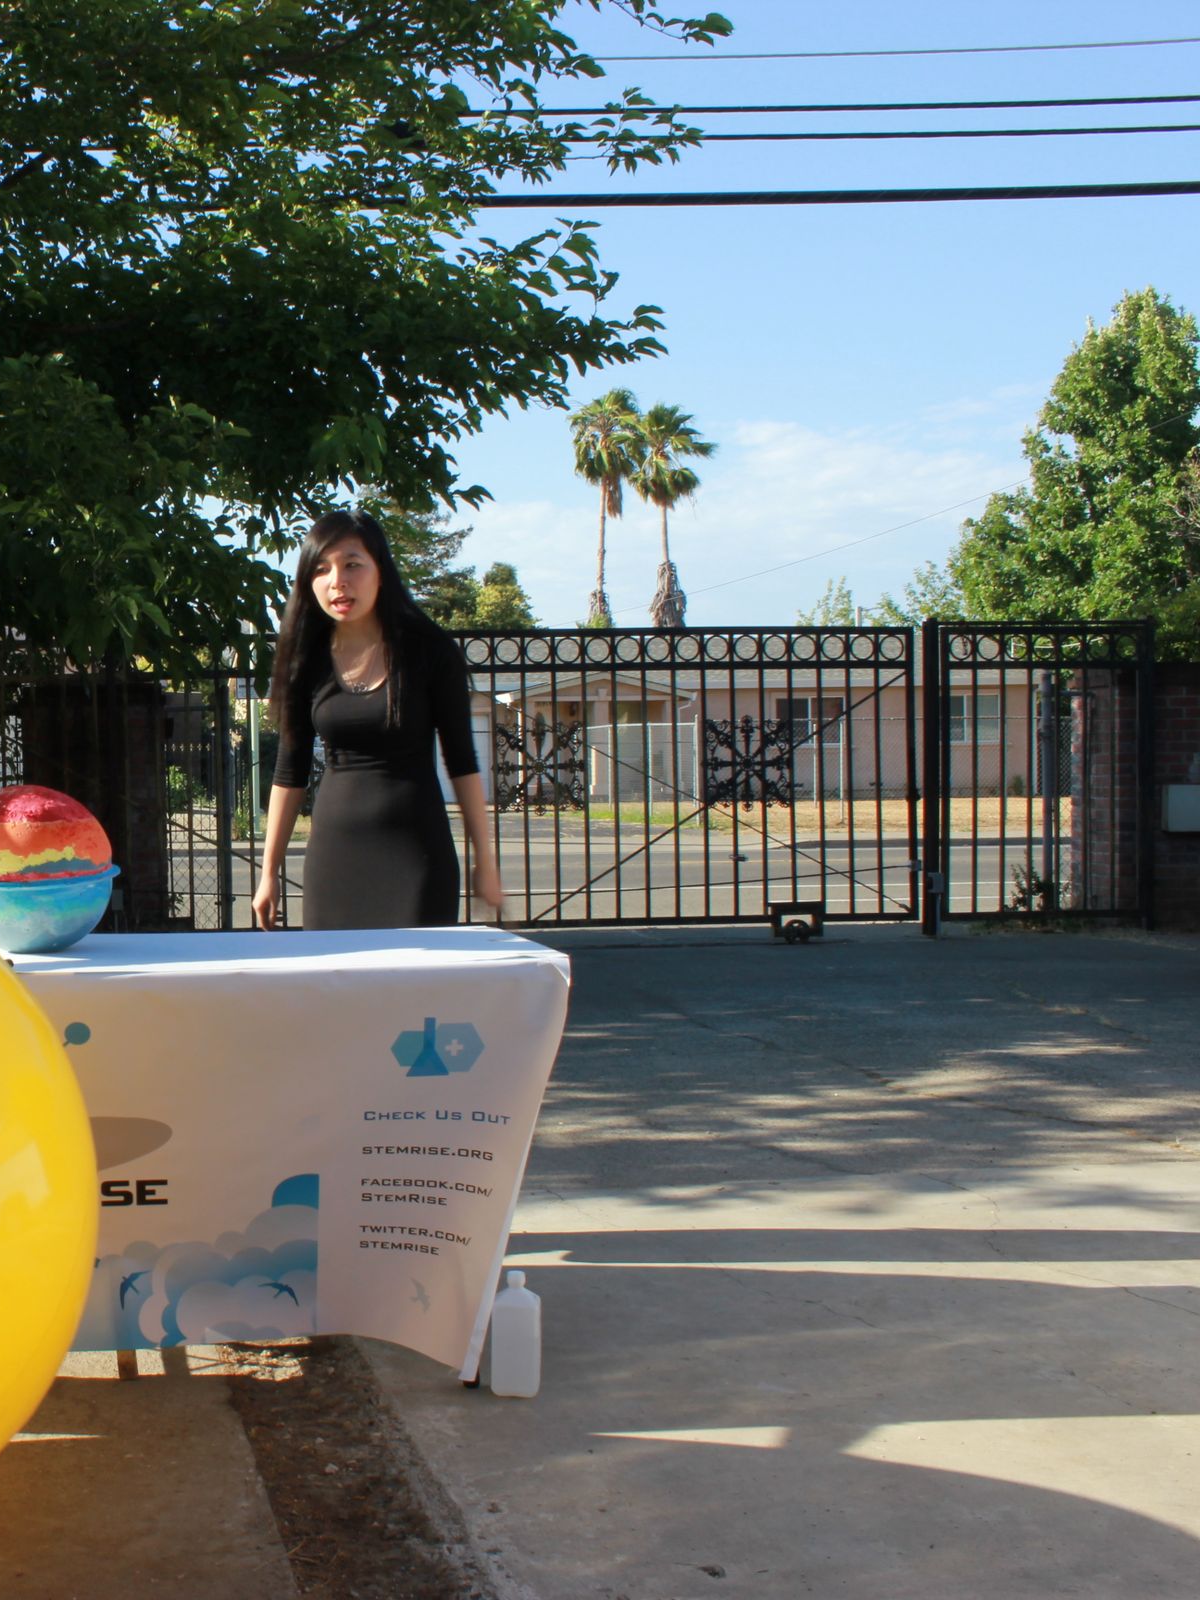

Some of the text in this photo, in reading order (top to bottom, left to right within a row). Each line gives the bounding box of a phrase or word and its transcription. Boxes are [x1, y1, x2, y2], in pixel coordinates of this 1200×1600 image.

[362, 1146, 493, 1161] STEMRISE.ORG
[361, 1179, 493, 1198] FACEBOOK.COM/
[360, 1225, 471, 1246] TWITTER.COM/
[360, 1241, 440, 1256] STEMRISE
